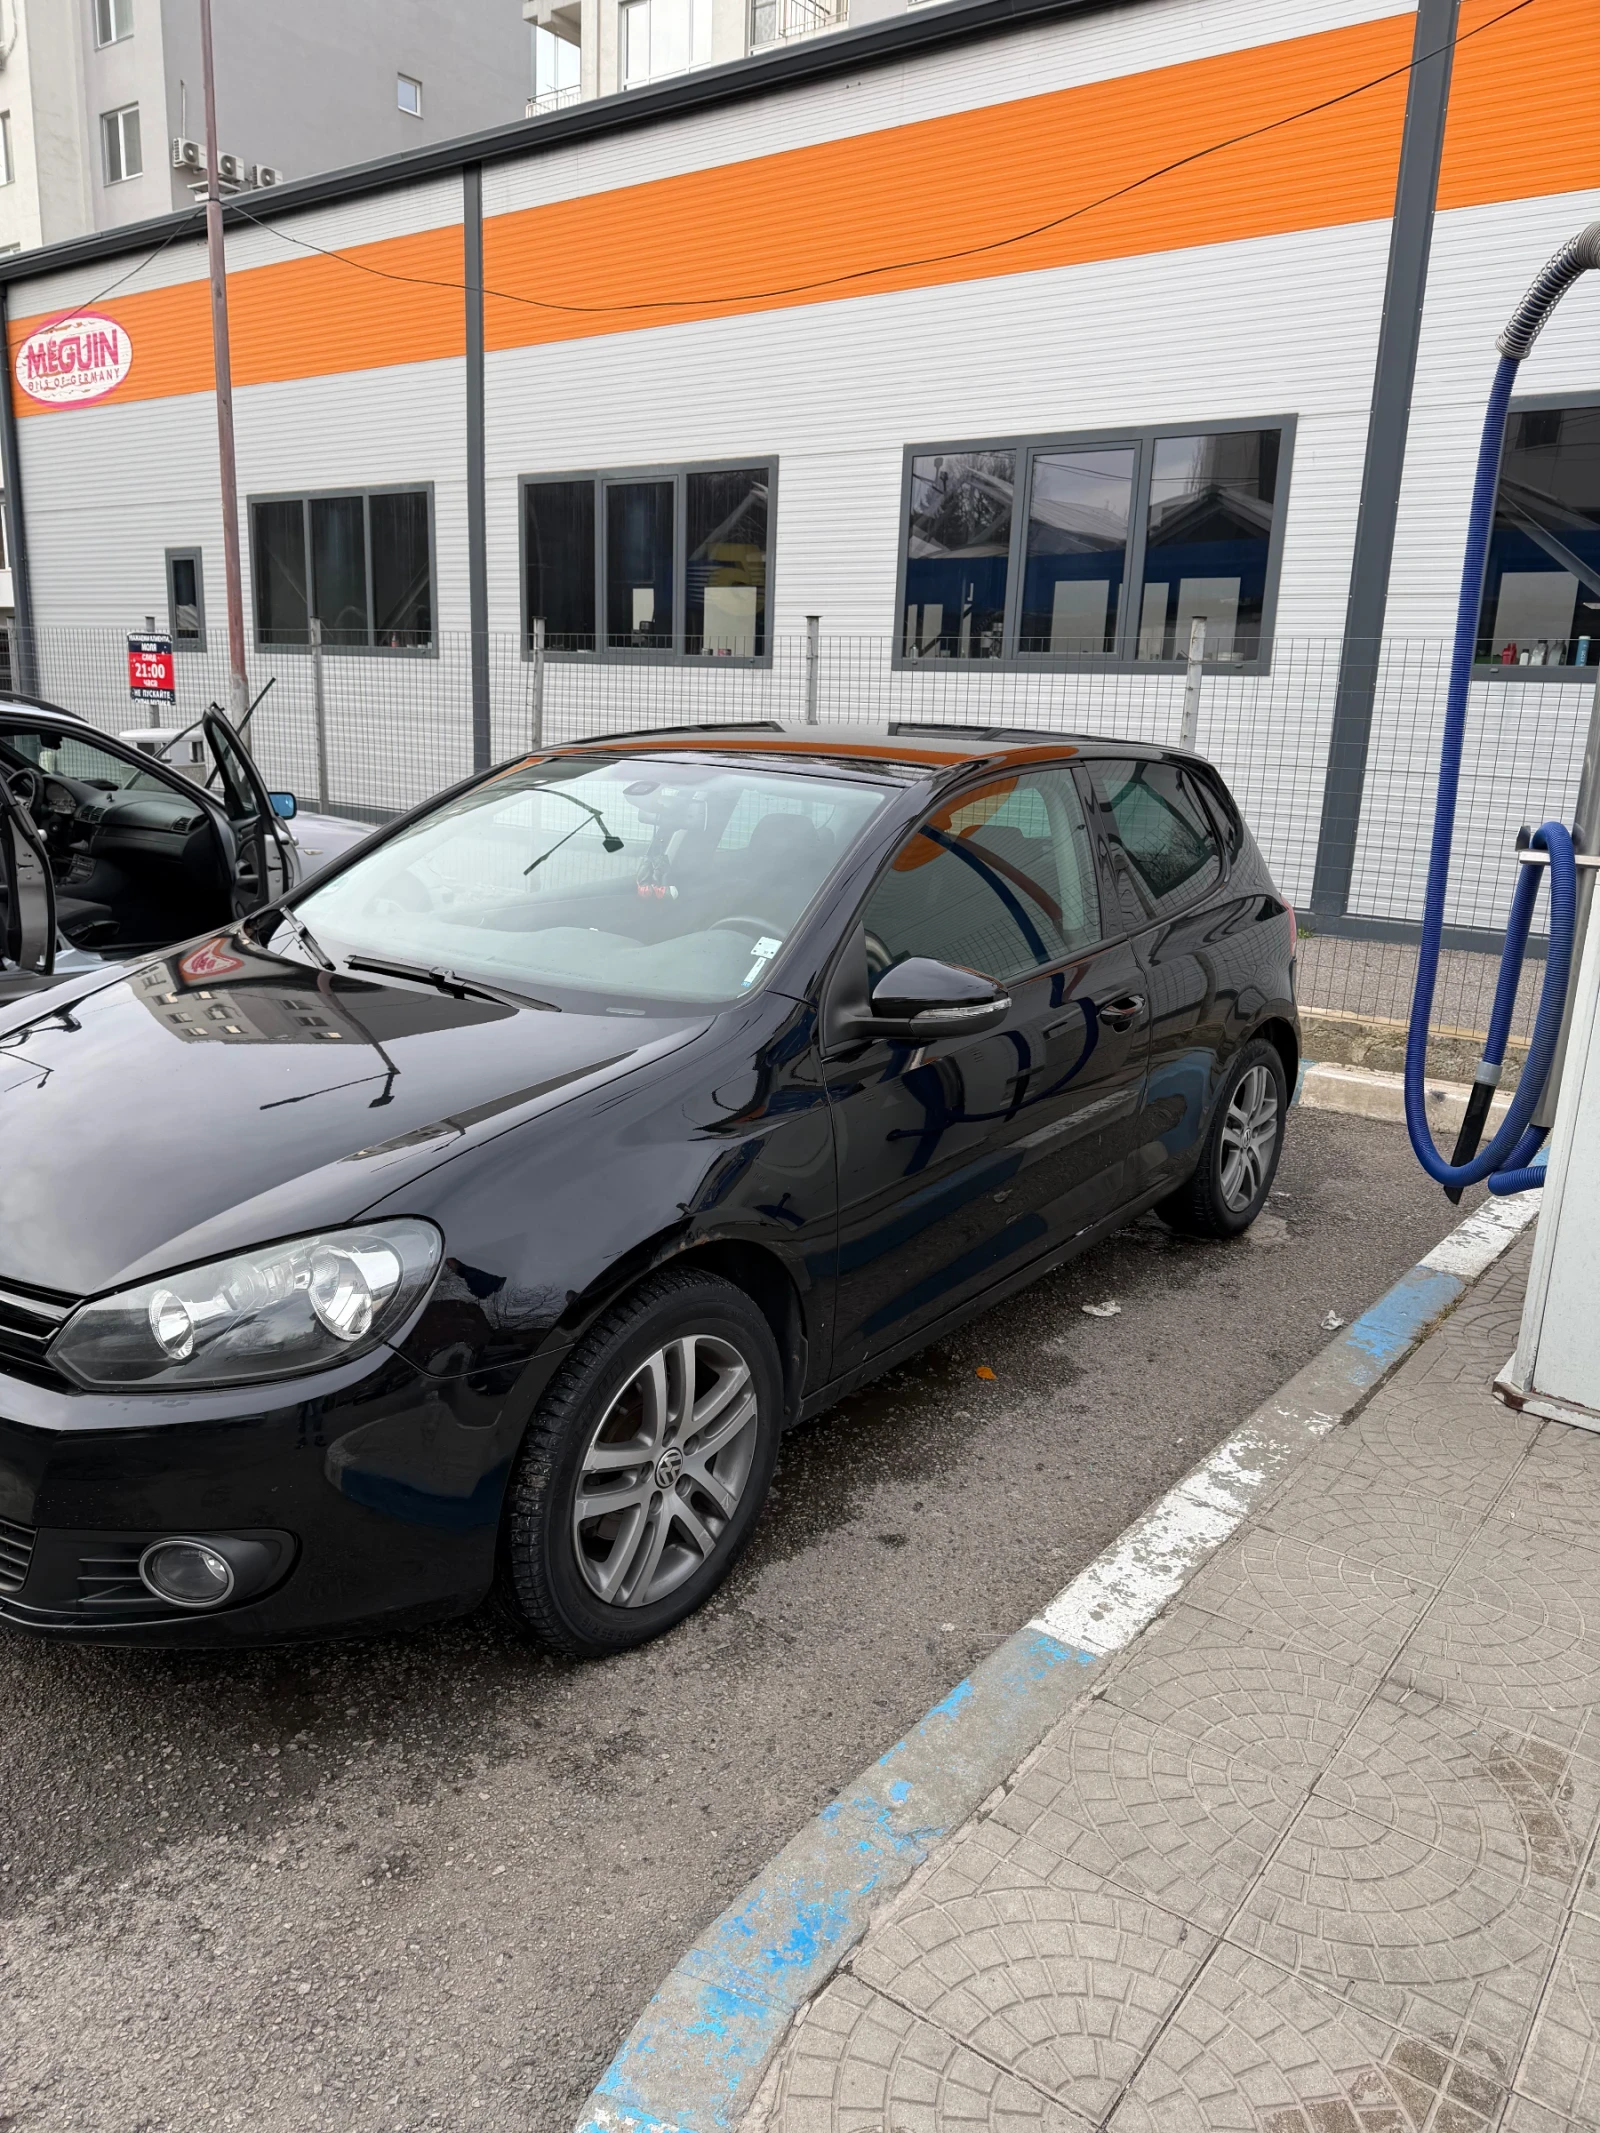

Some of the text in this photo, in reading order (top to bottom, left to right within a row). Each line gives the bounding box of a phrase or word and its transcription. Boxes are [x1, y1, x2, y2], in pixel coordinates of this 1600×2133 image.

[70, 367, 120, 385] GERMANY
[134, 662, 166, 679] 21:00
[142, 689, 171, 699] ПУСКАЙТЕ
